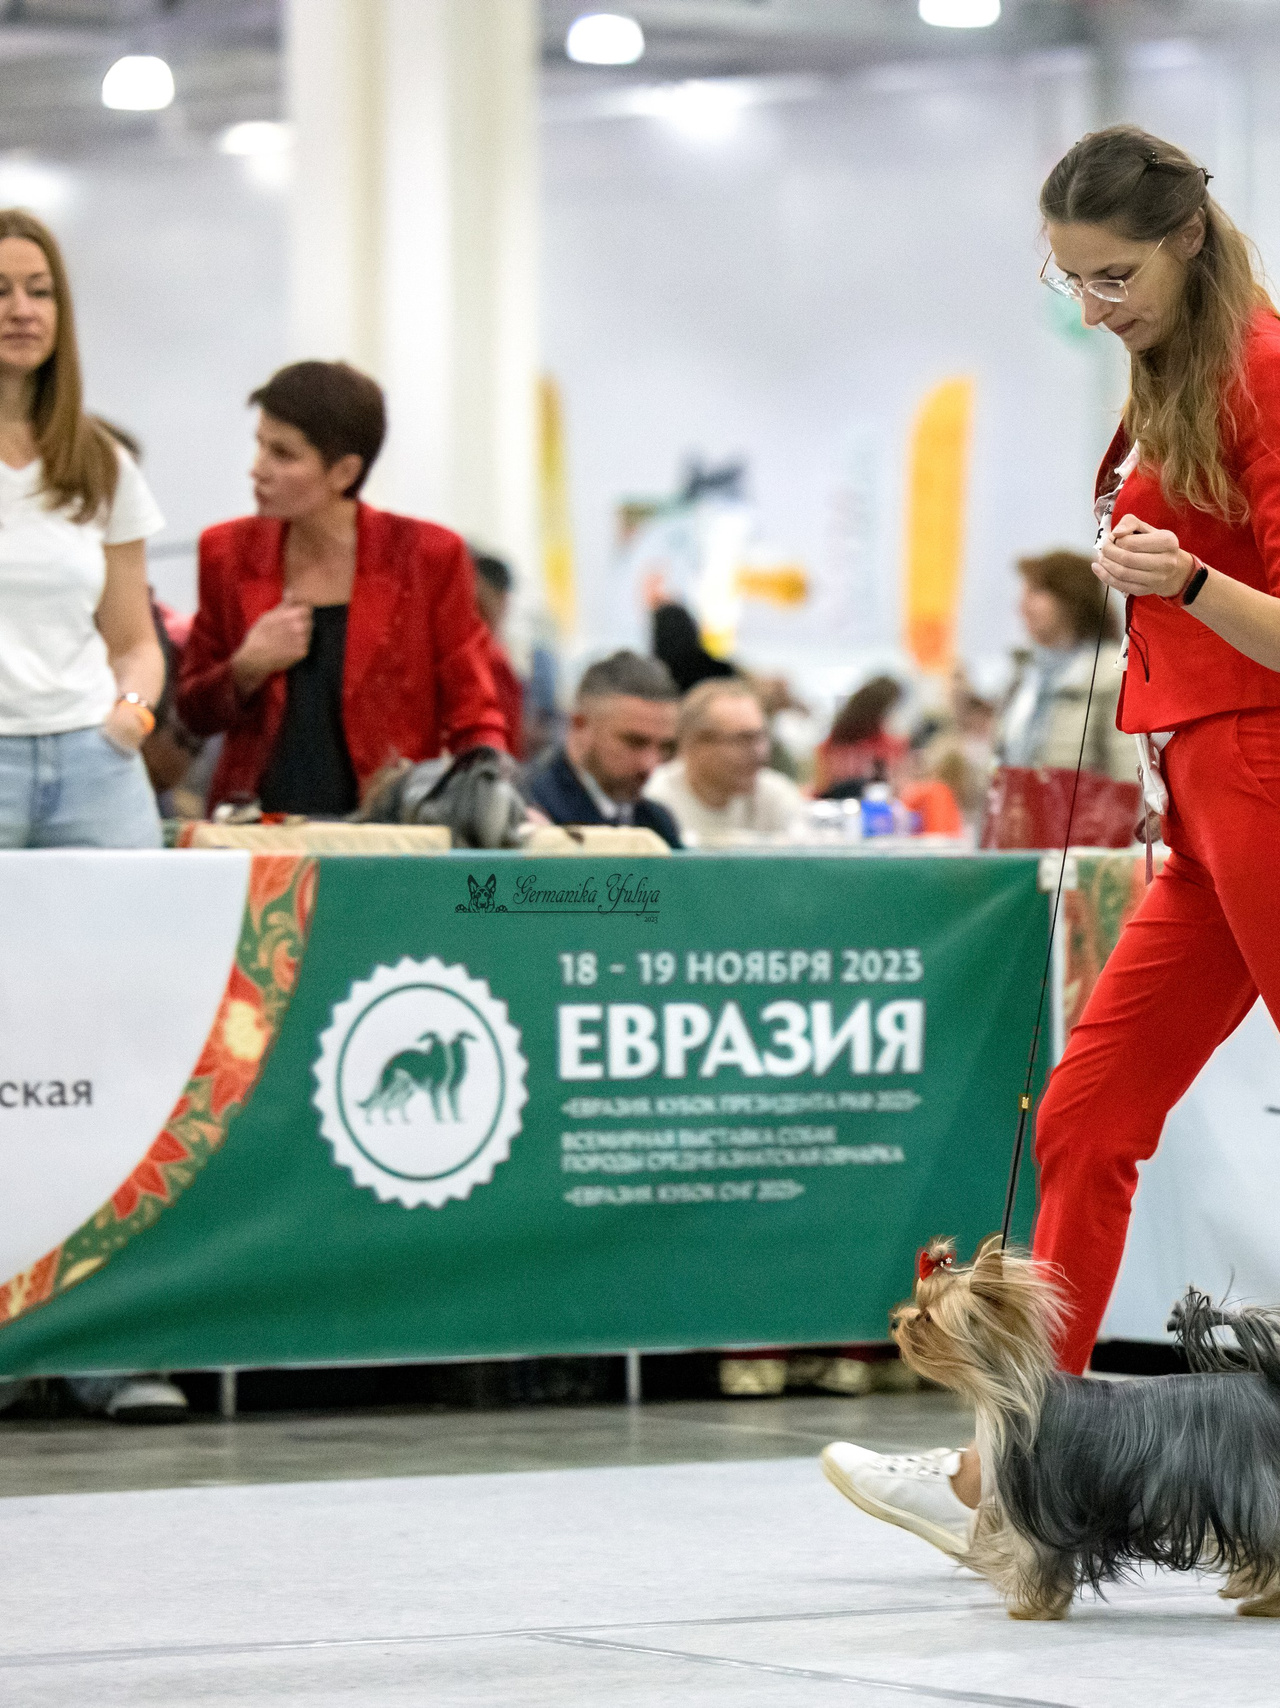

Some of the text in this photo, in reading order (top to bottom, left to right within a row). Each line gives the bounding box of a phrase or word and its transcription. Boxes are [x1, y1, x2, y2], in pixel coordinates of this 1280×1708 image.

[560, 950, 597, 986] 18
[637, 951, 676, 985] 19
[686, 950, 832, 984] НОЯБРЯ
[841, 948, 924, 983] 2023
[557, 998, 924, 1081] ЕВРАЗИЯ
[0, 1080, 92, 1107] ская
